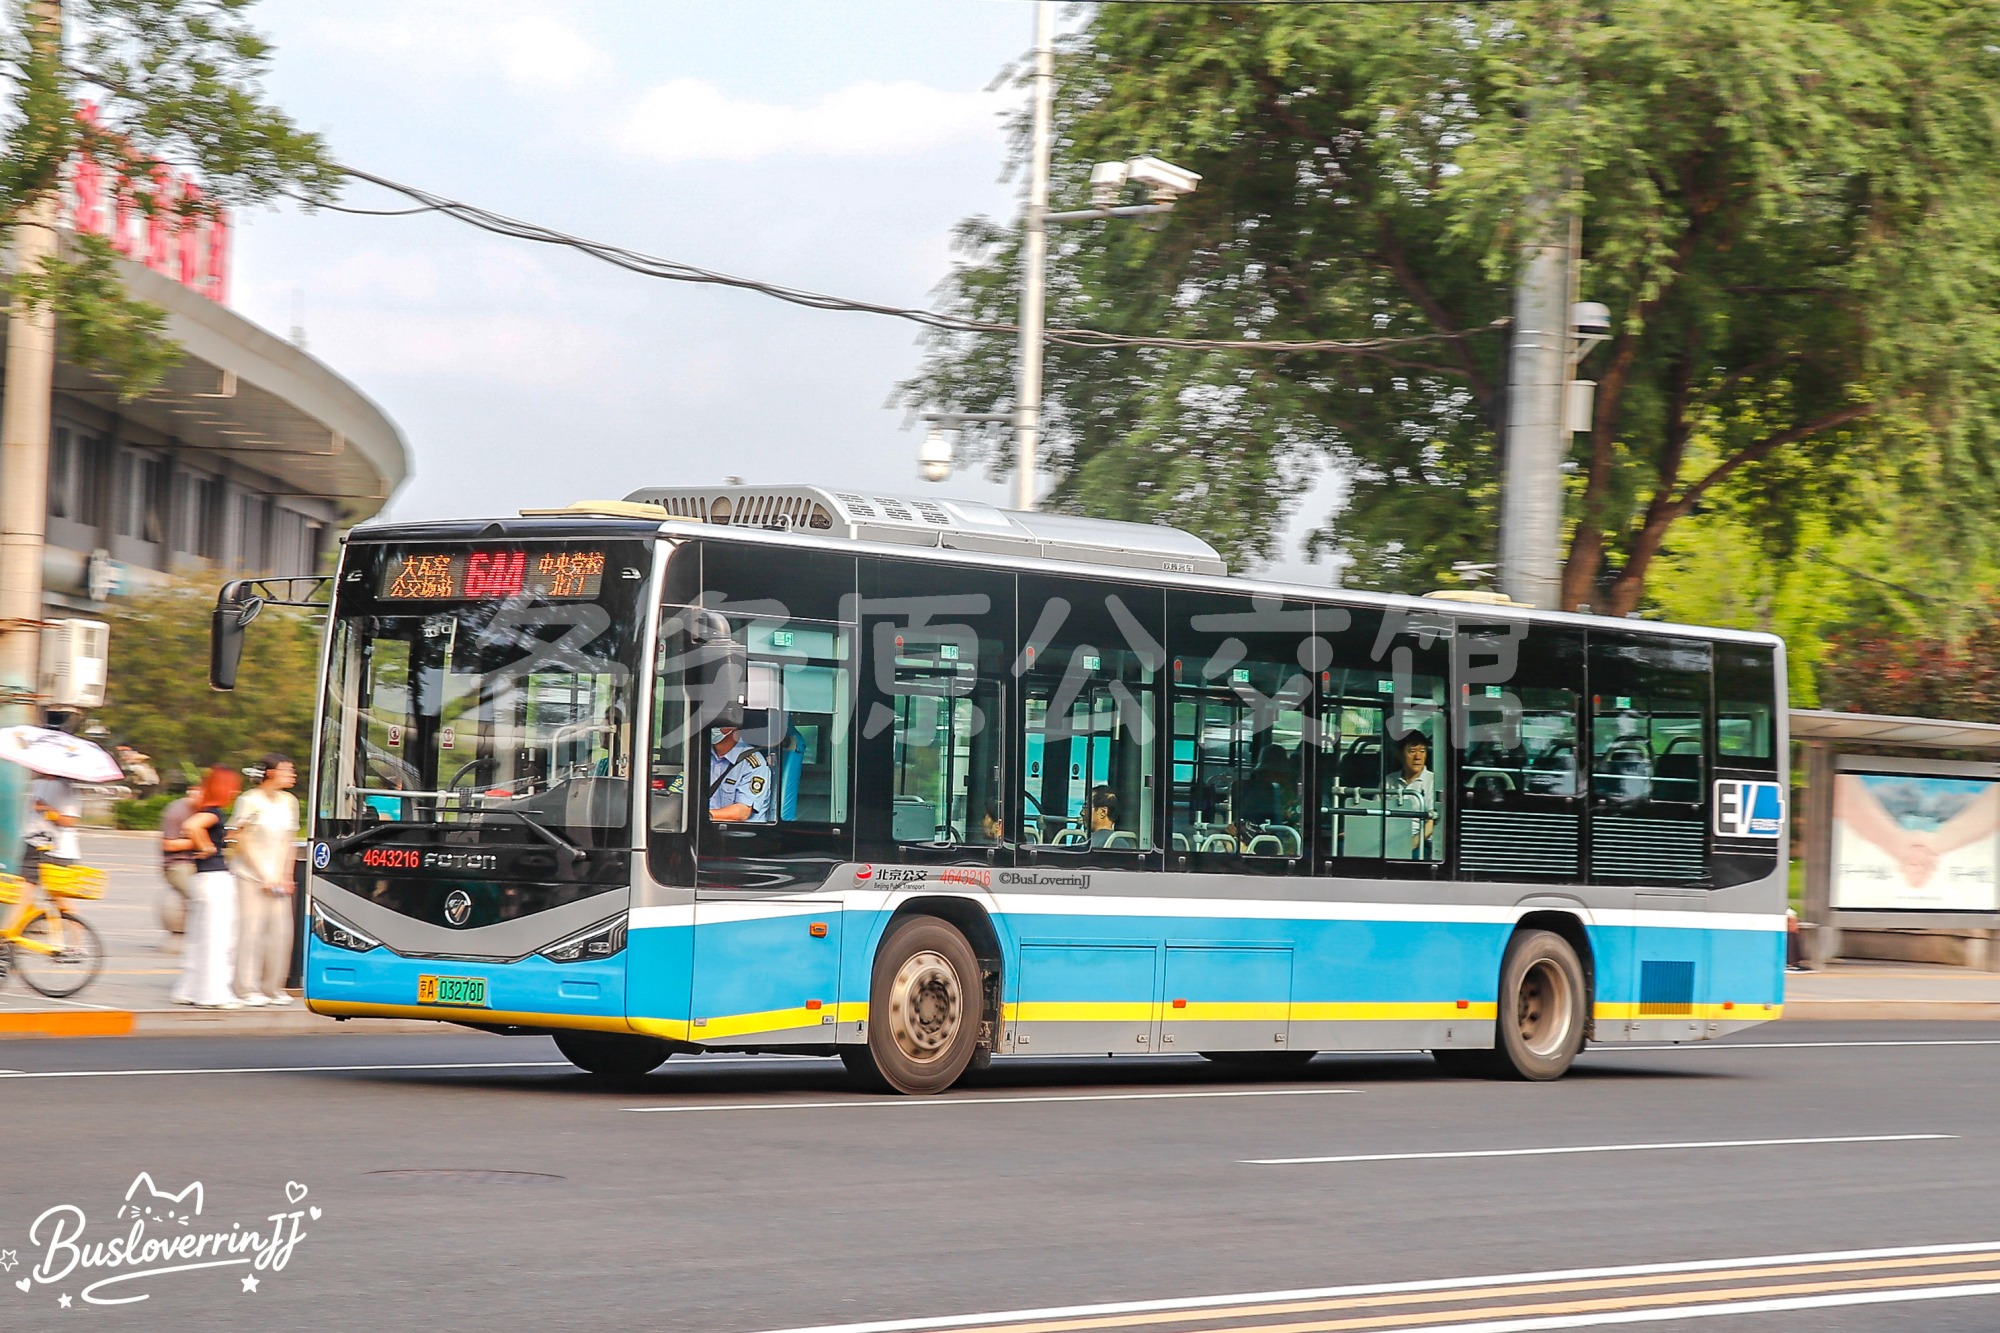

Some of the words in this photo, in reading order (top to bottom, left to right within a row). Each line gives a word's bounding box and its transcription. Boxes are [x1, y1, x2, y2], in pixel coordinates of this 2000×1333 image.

[402, 554, 451, 578] 大瓦窑
[464, 552, 525, 597] 644
[538, 552, 605, 575] 中央党校
[390, 576, 454, 598] 公交场站
[548, 574, 586, 596] 北门
[363, 848, 419, 868] 4643216
[424, 852, 497, 870] FOTON
[873, 881, 889, 891] Beijing
[903, 883, 925, 891] Transport
[876, 869, 928, 881] 北京公交
[939, 868, 991, 886] 4643216
